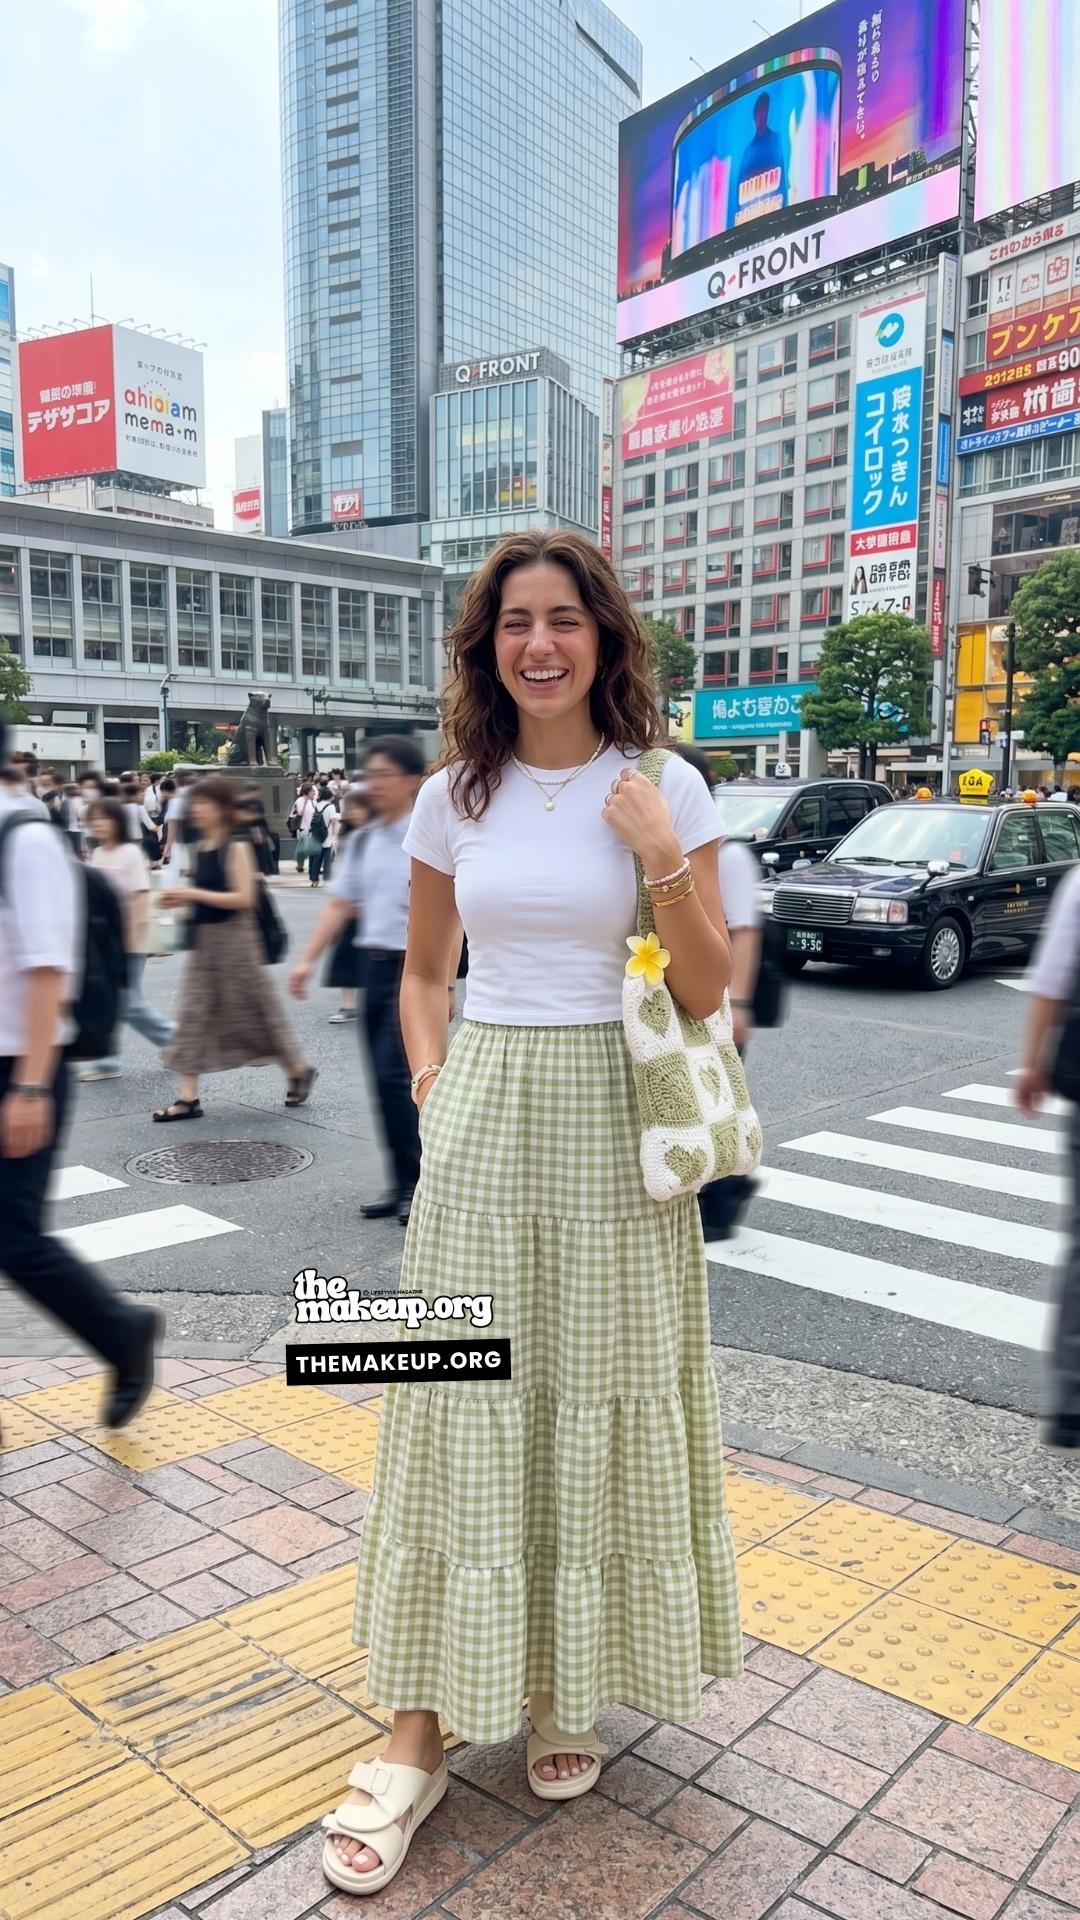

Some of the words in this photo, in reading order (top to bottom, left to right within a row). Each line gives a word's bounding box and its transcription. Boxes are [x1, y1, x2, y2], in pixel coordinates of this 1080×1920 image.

[863, 391, 886, 516] コイロック
